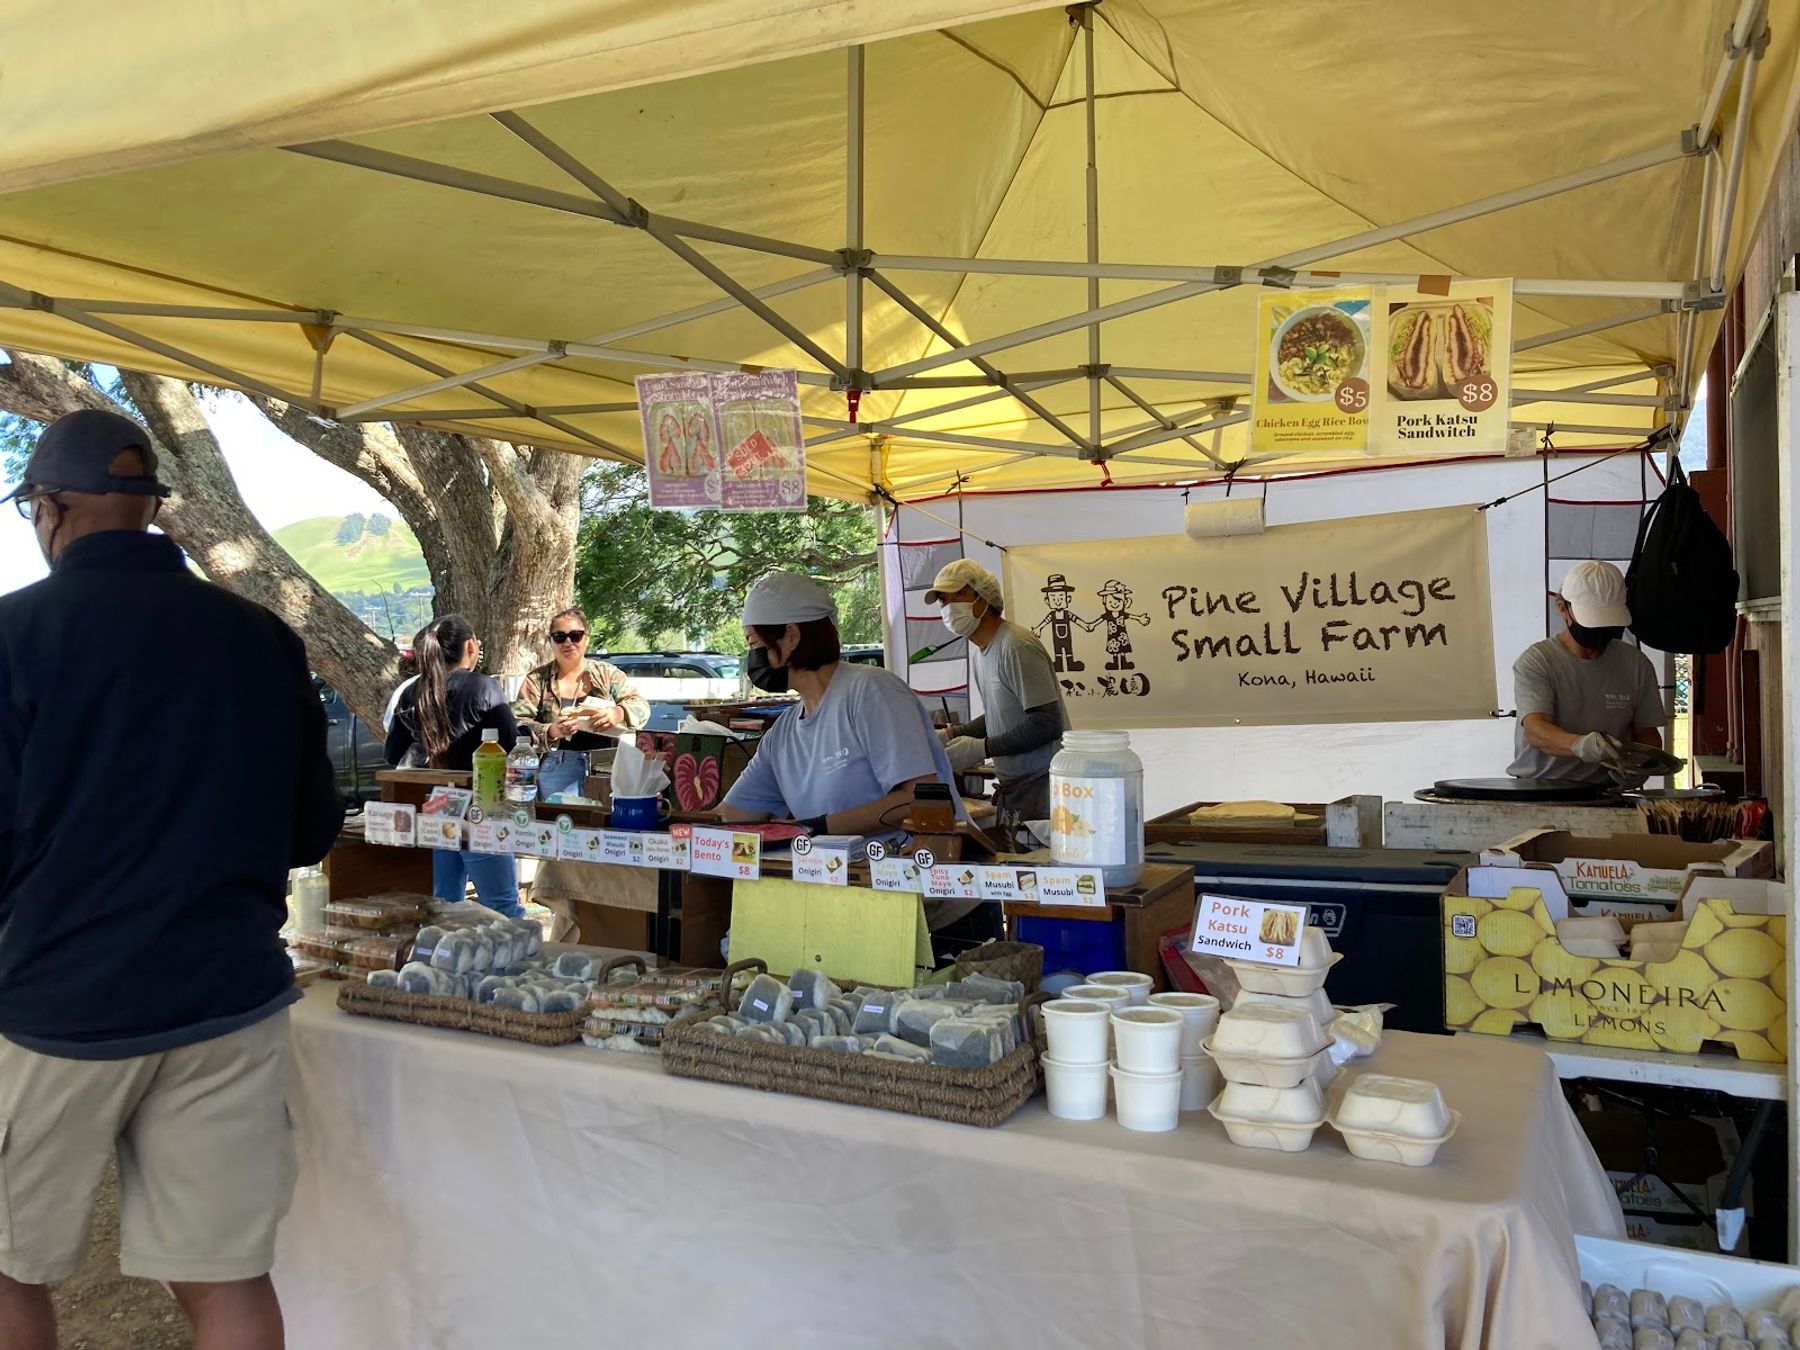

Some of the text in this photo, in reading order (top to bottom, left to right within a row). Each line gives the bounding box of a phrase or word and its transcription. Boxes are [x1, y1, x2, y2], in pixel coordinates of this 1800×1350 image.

[1339, 386, 1366, 408] $5
[1462, 382, 1493, 403] $8
[1256, 416, 1369, 429] Chicken Egg Rice Bow
[1397, 413, 1478, 427] Pork Katsu
[1397, 425, 1476, 440] Sandwitch
[735, 438, 758, 461] SOLD
[781, 480, 801, 496] $8
[1160, 570, 1457, 620] Pine Village
[1170, 617, 1449, 662] Small Farm
[1237, 667, 1377, 690] Kona, Hawaii
[1062, 782, 1094, 798] Box
[470, 809, 481, 820] GF
[672, 828, 690, 838] NEW
[515, 840, 536, 849] Onigiri
[694, 836, 729, 850] Today's
[796, 838, 809, 851] GF
[869, 843, 883, 855] GF
[562, 849, 583, 858] Onigiri
[604, 848, 626, 857] Onigiri
[694, 849, 722, 862] Bento
[917, 852, 931, 864] GF
[648, 855, 670, 864] Onigiri
[738, 865, 750, 876] $8
[798, 867, 822, 877] Onigiri
[985, 870, 1011, 880] Spam
[1576, 861, 1628, 880] KAMUELA
[875, 878, 900, 888] Onigiri
[985, 881, 1015, 889] Musubi
[1043, 875, 1071, 886] Spam
[929, 887, 956, 896] Onigiri
[1042, 887, 1074, 896] Musubi
[1211, 901, 1250, 918] Pork
[1207, 918, 1248, 935] Katsu
[1197, 934, 1252, 951] Sandwich
[1266, 946, 1284, 960] $8
[1513, 973, 1728, 1013] LIMONEIRA
[1574, 1013, 1666, 1035] LEMONS
